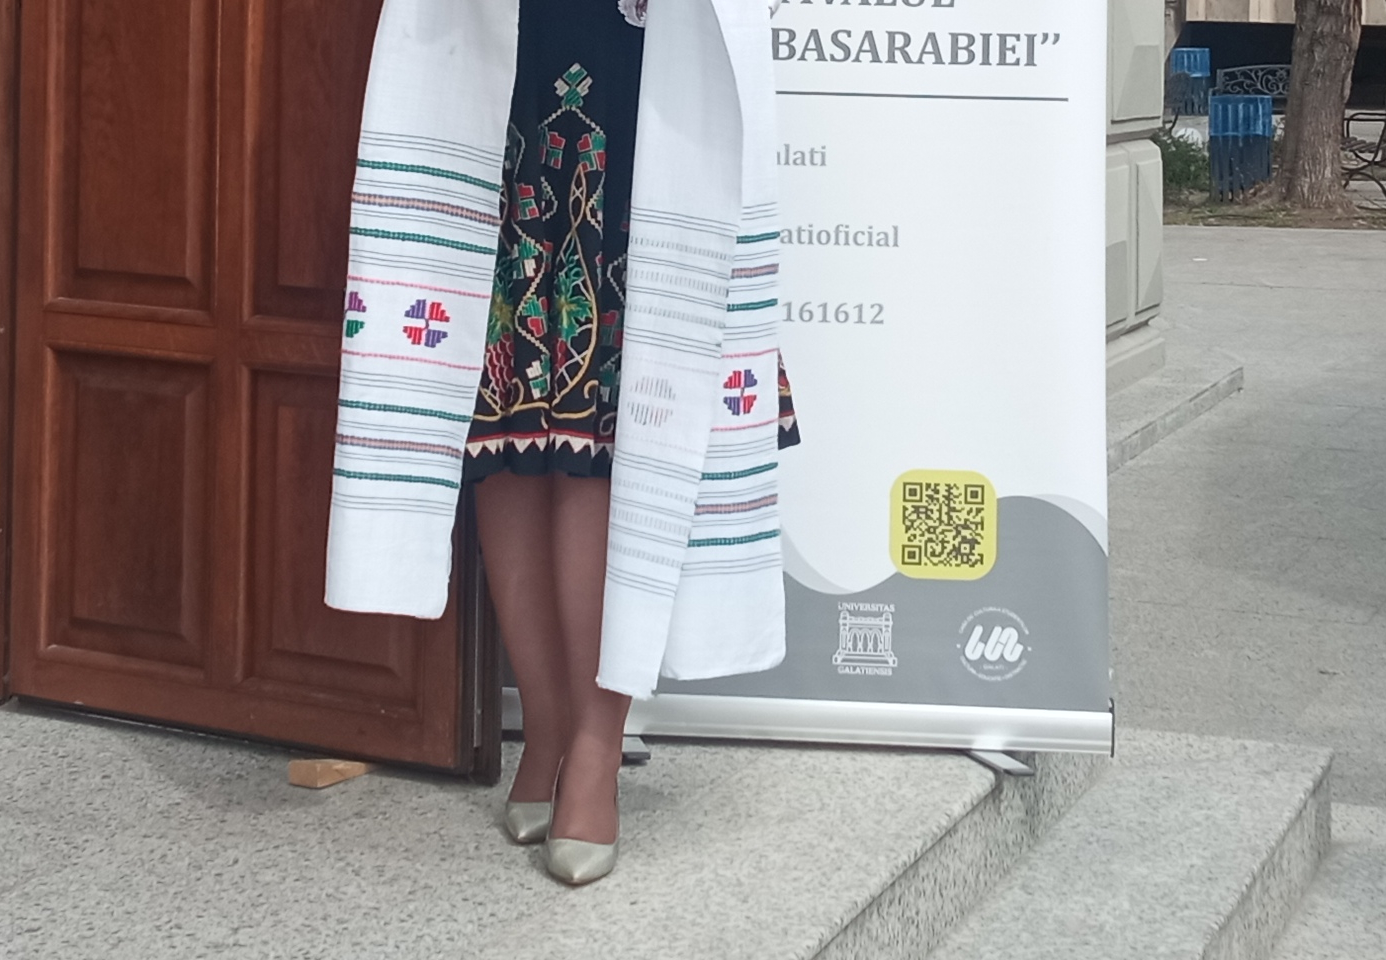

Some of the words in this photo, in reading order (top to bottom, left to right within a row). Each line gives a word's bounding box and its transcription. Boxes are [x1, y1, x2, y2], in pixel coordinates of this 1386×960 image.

[779, 224, 900, 248] atioficial
[781, 301, 885, 325] 161612
[838, 601, 895, 612] UNIVERSITAS
